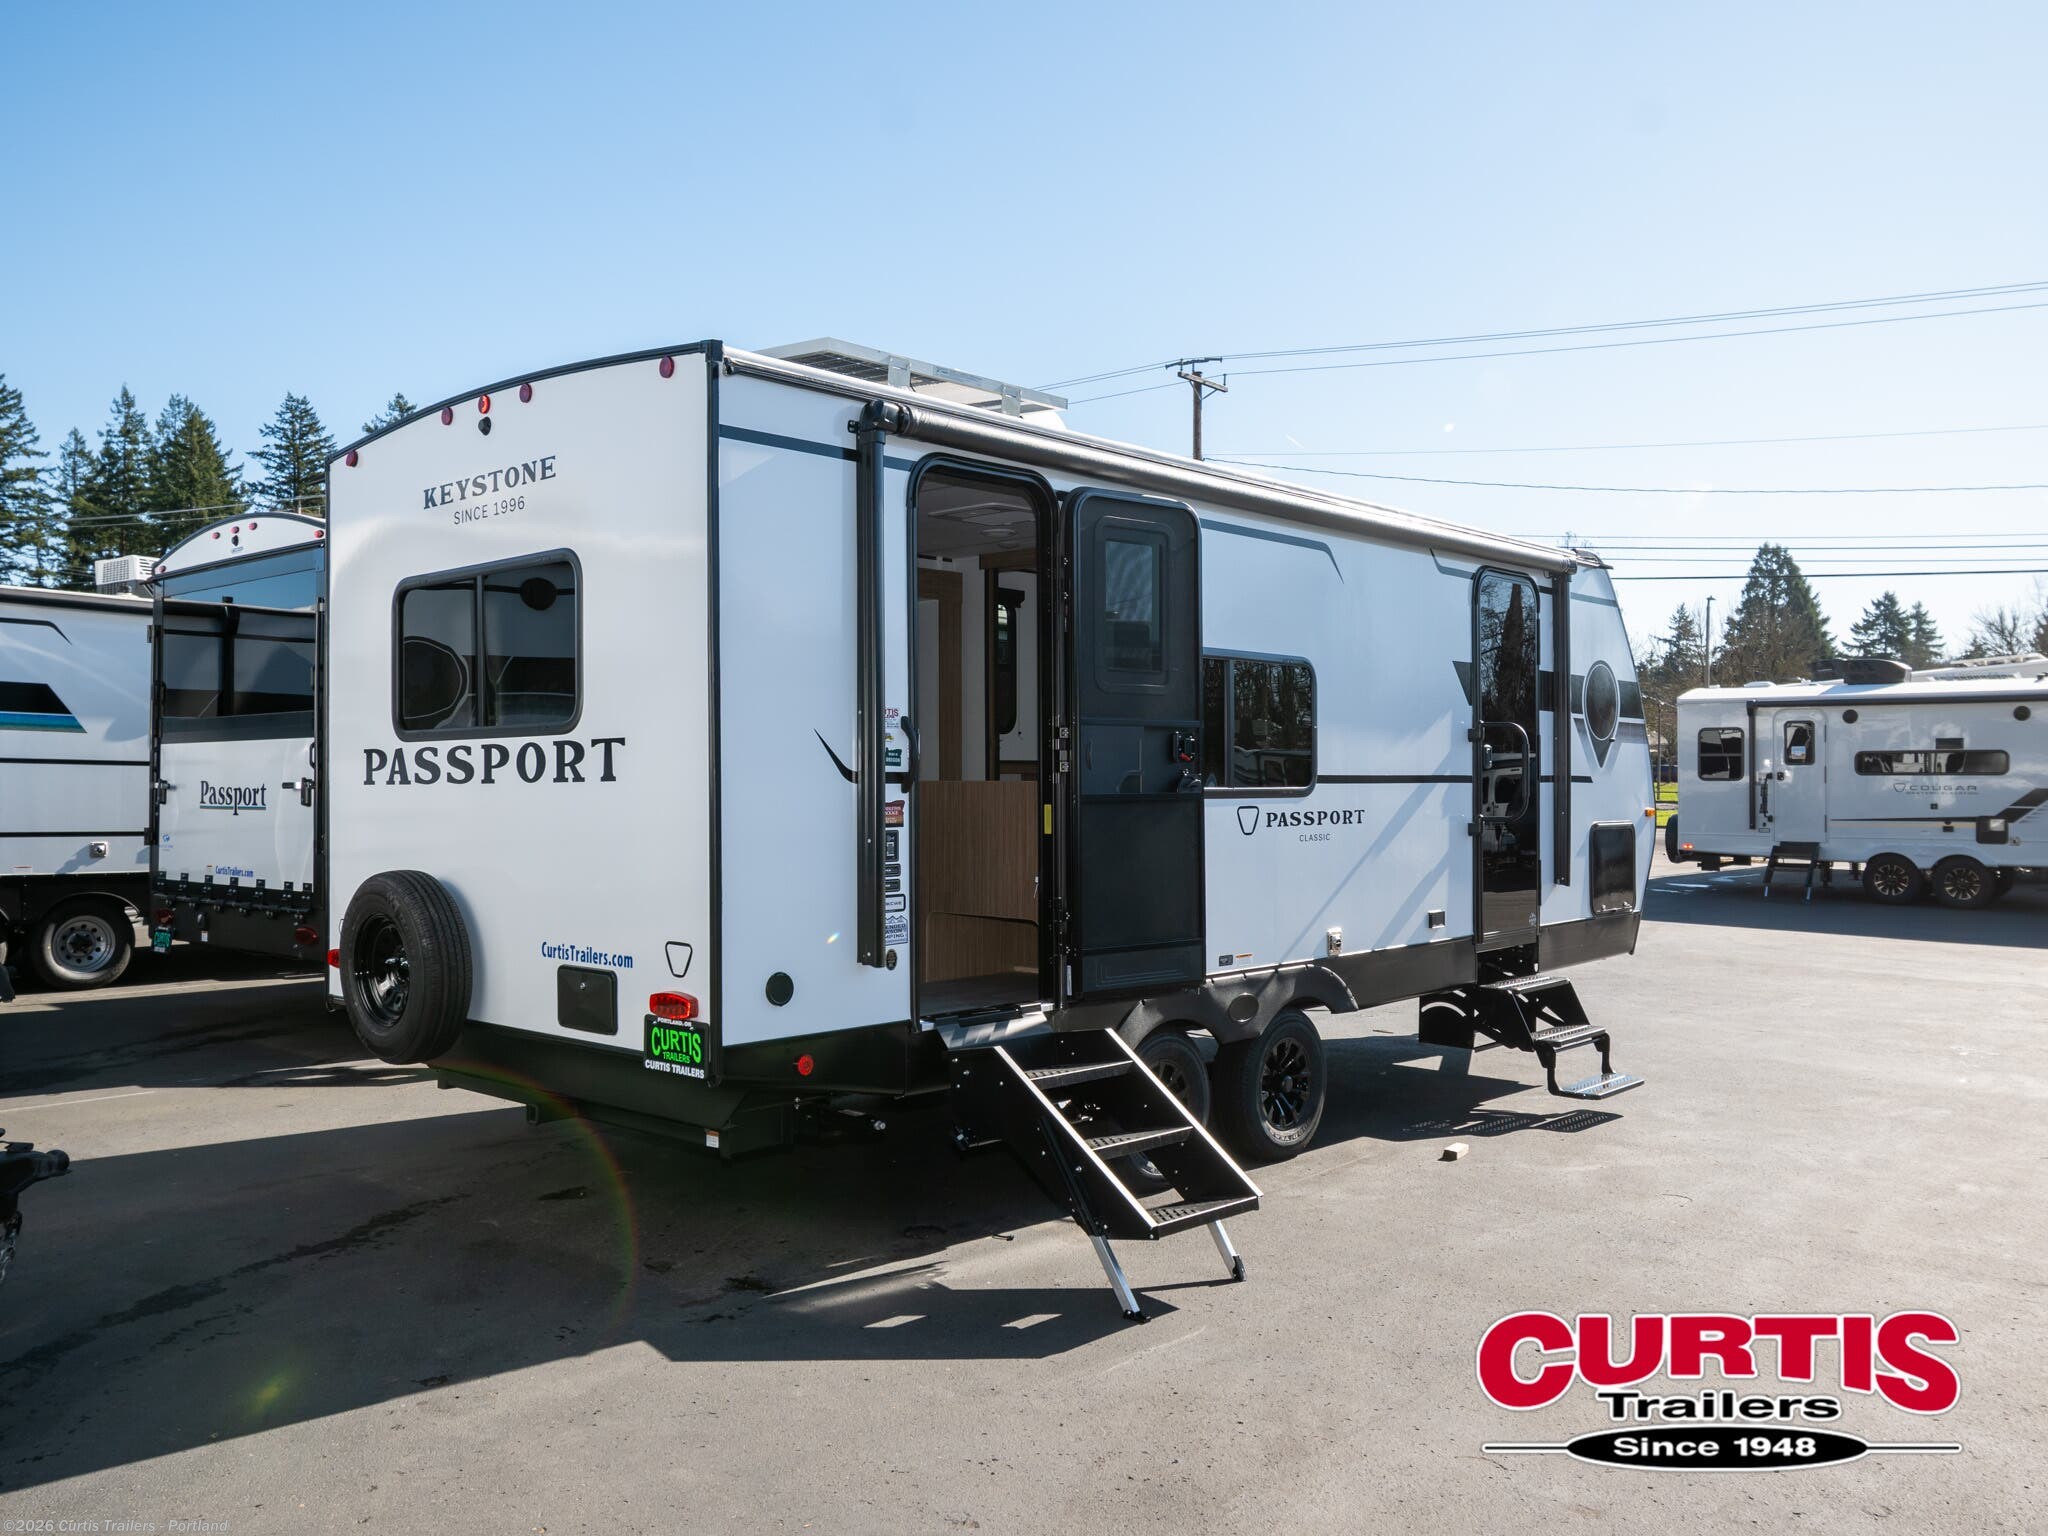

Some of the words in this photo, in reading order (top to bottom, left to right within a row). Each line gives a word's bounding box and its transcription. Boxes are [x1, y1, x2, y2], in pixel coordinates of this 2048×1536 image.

[423, 455, 557, 510] KEYSTONE
[454, 504, 489, 525] SINCE
[493, 495, 525, 516] 1996
[363, 737, 626, 786] PASSPORT
[200, 780, 267, 816] Passport
[1909, 784, 1977, 792] COUGAR
[1265, 809, 1366, 828] PASSPORT
[1299, 833, 1331, 842] CLASSIC
[541, 941, 634, 969] CurtisTrailers.com
[651, 1026, 702, 1064] CURTIS
[662, 1051, 691, 1064] TRAILERS
[645, 1059, 671, 1073] CURTIS
[671, 1064, 705, 1079] TRAILERS
